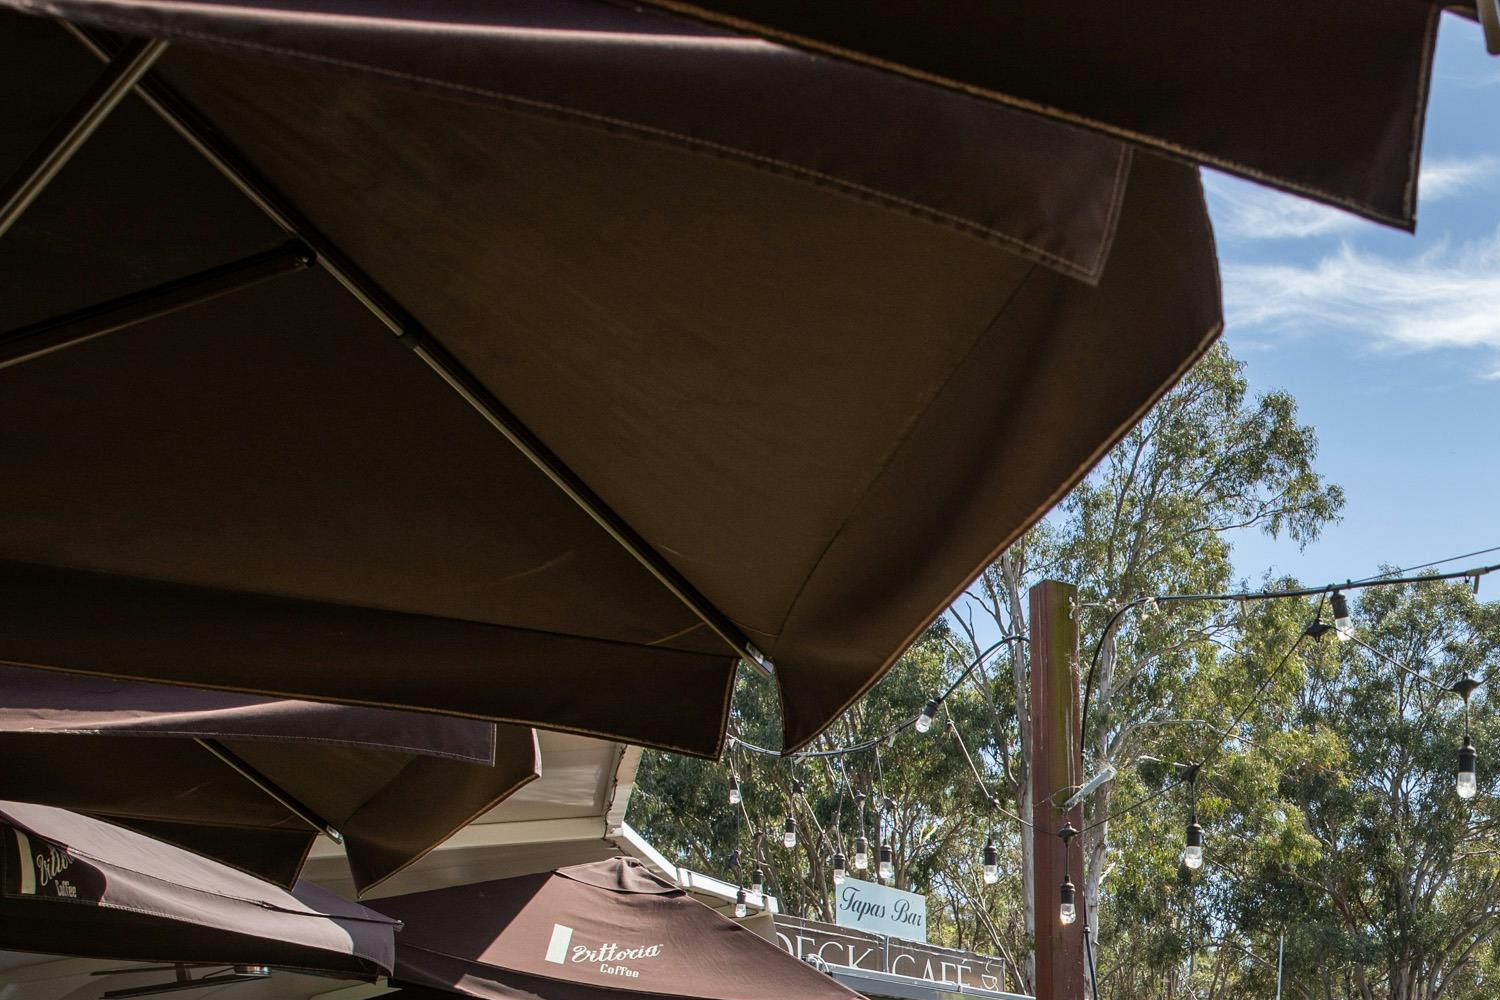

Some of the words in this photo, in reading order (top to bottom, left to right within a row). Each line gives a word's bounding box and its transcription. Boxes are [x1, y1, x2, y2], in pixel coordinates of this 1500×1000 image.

[840, 886, 886, 921] Tapas
[891, 899, 922, 927] Bar
[571, 943, 661, 963] Vittoria
[600, 963, 640, 978] Coffee
[892, 954, 972, 987] CAFÉ
